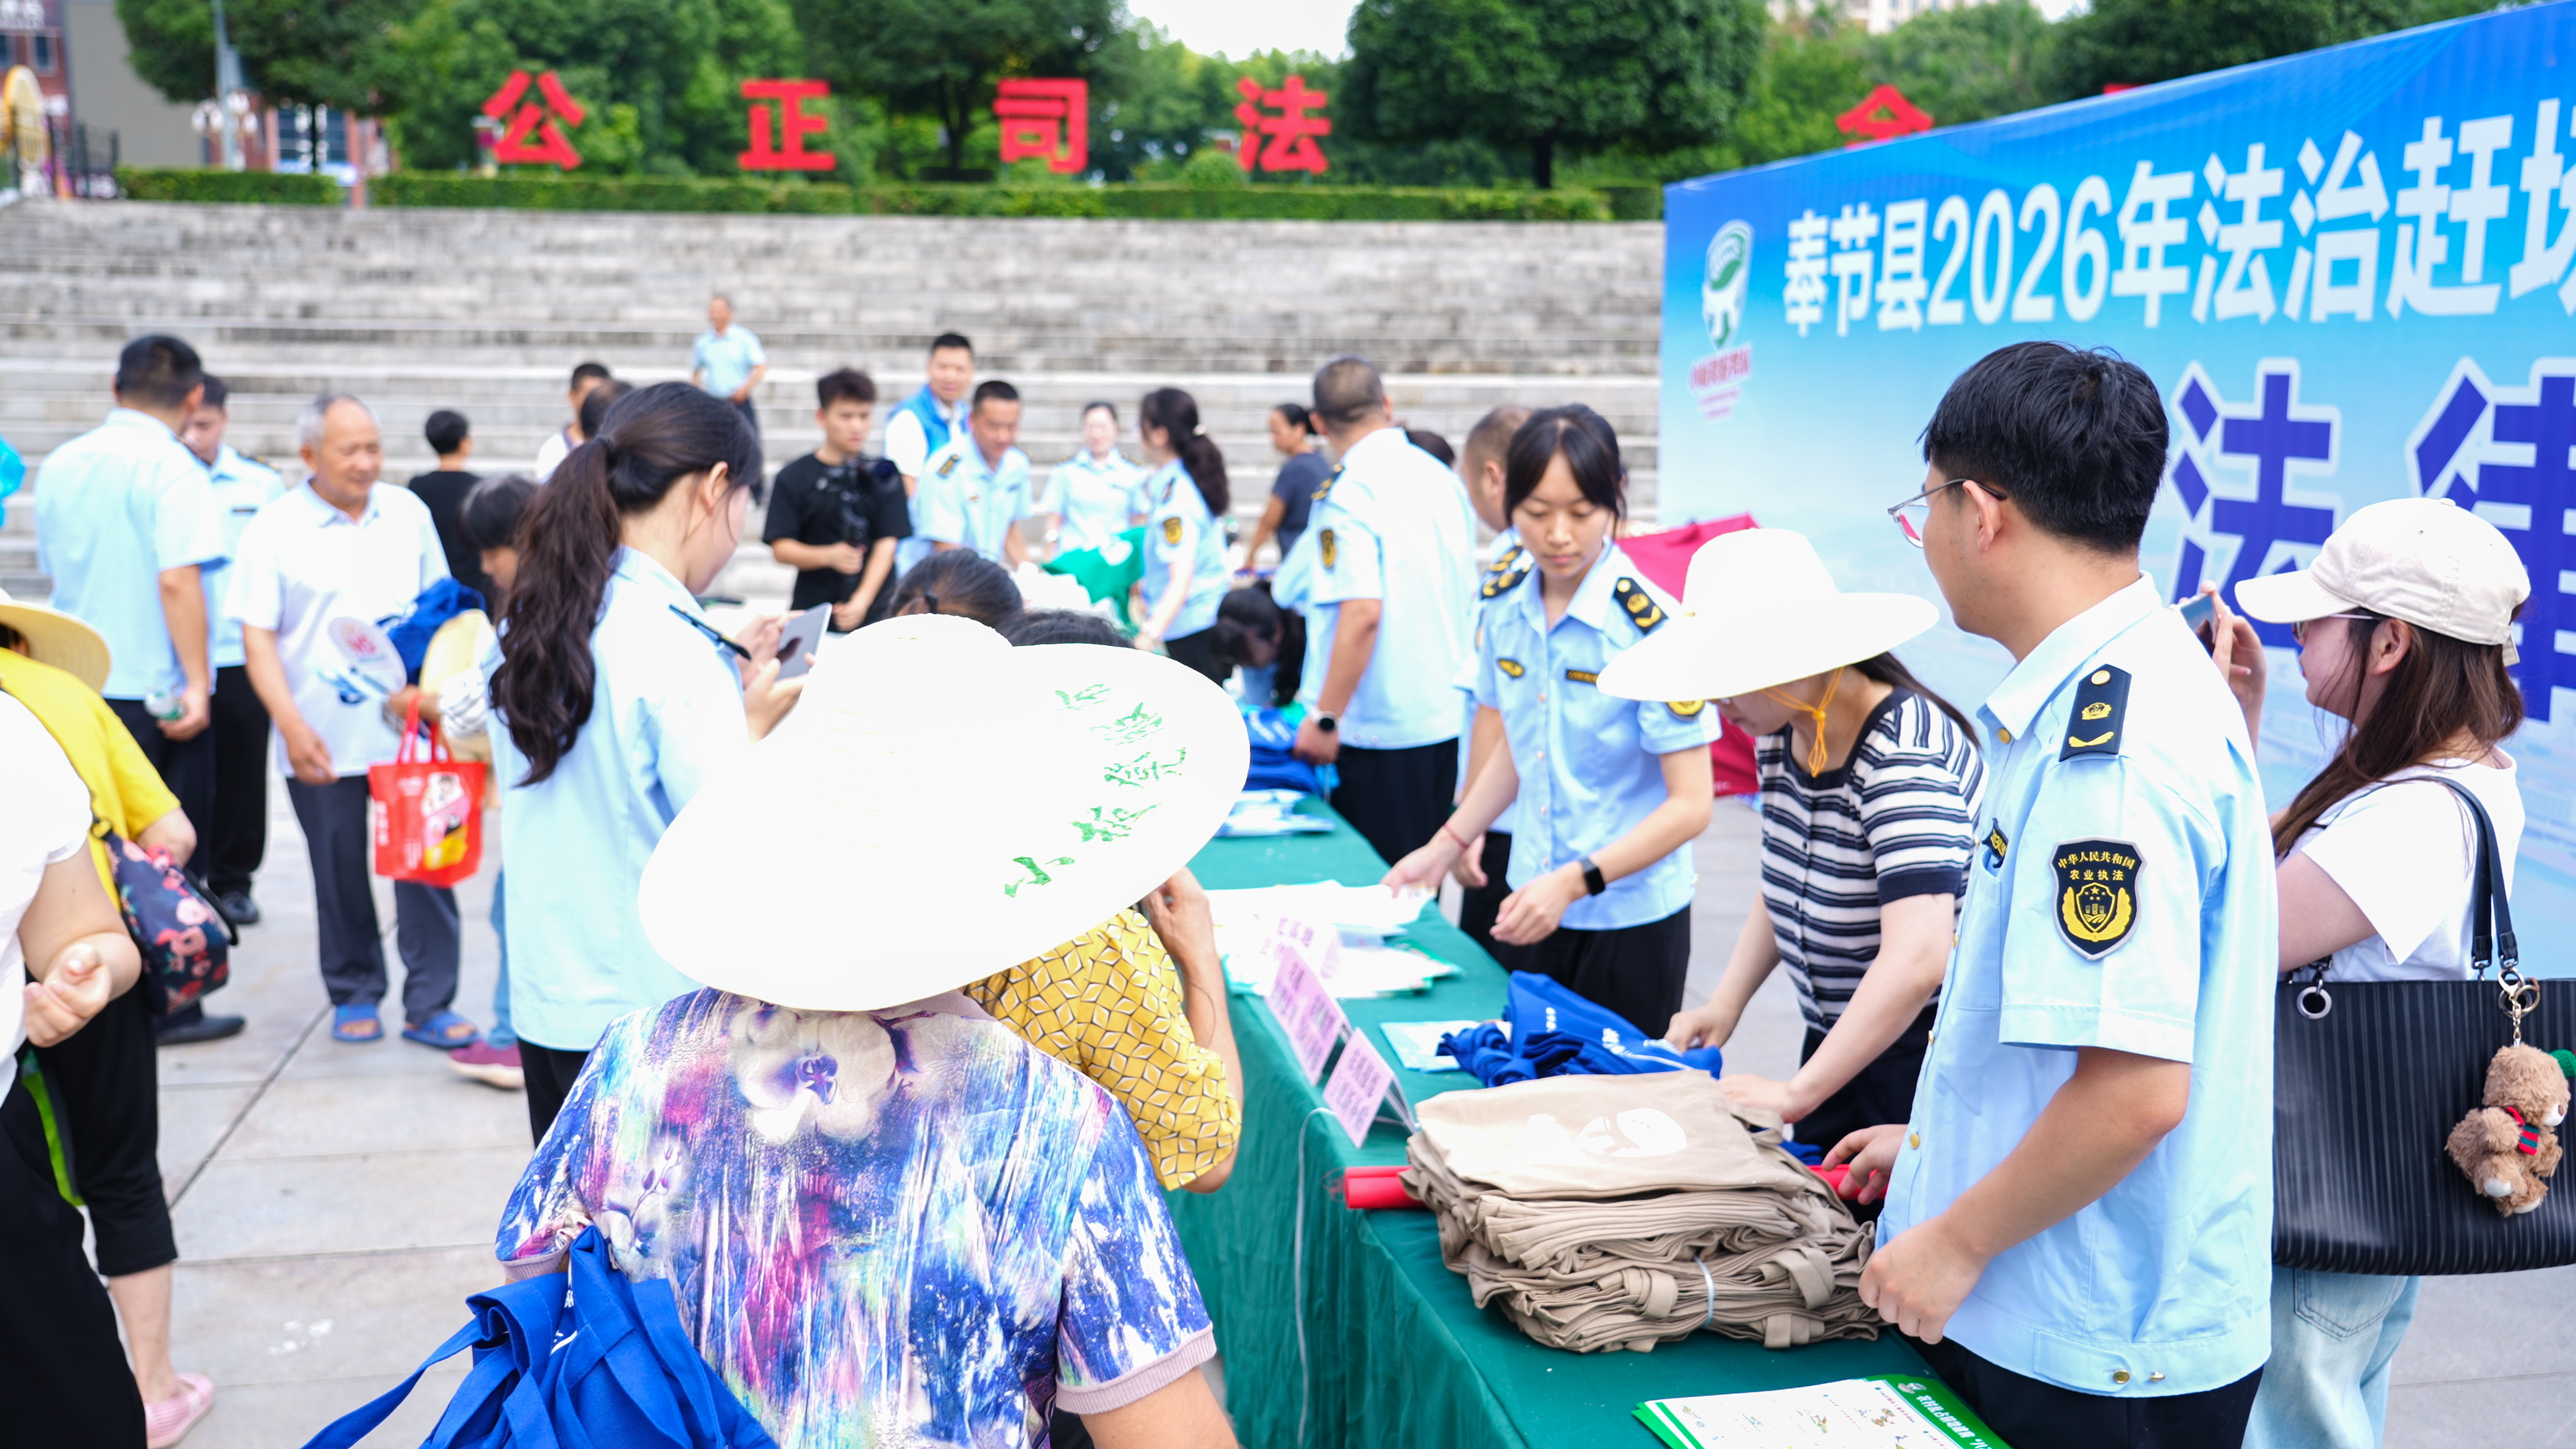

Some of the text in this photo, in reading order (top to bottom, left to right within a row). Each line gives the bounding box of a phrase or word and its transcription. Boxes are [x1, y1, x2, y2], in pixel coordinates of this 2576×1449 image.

[2058, 851, 2136, 870] 中华人民共和国
[2069, 869, 2125, 881] 农业执法
